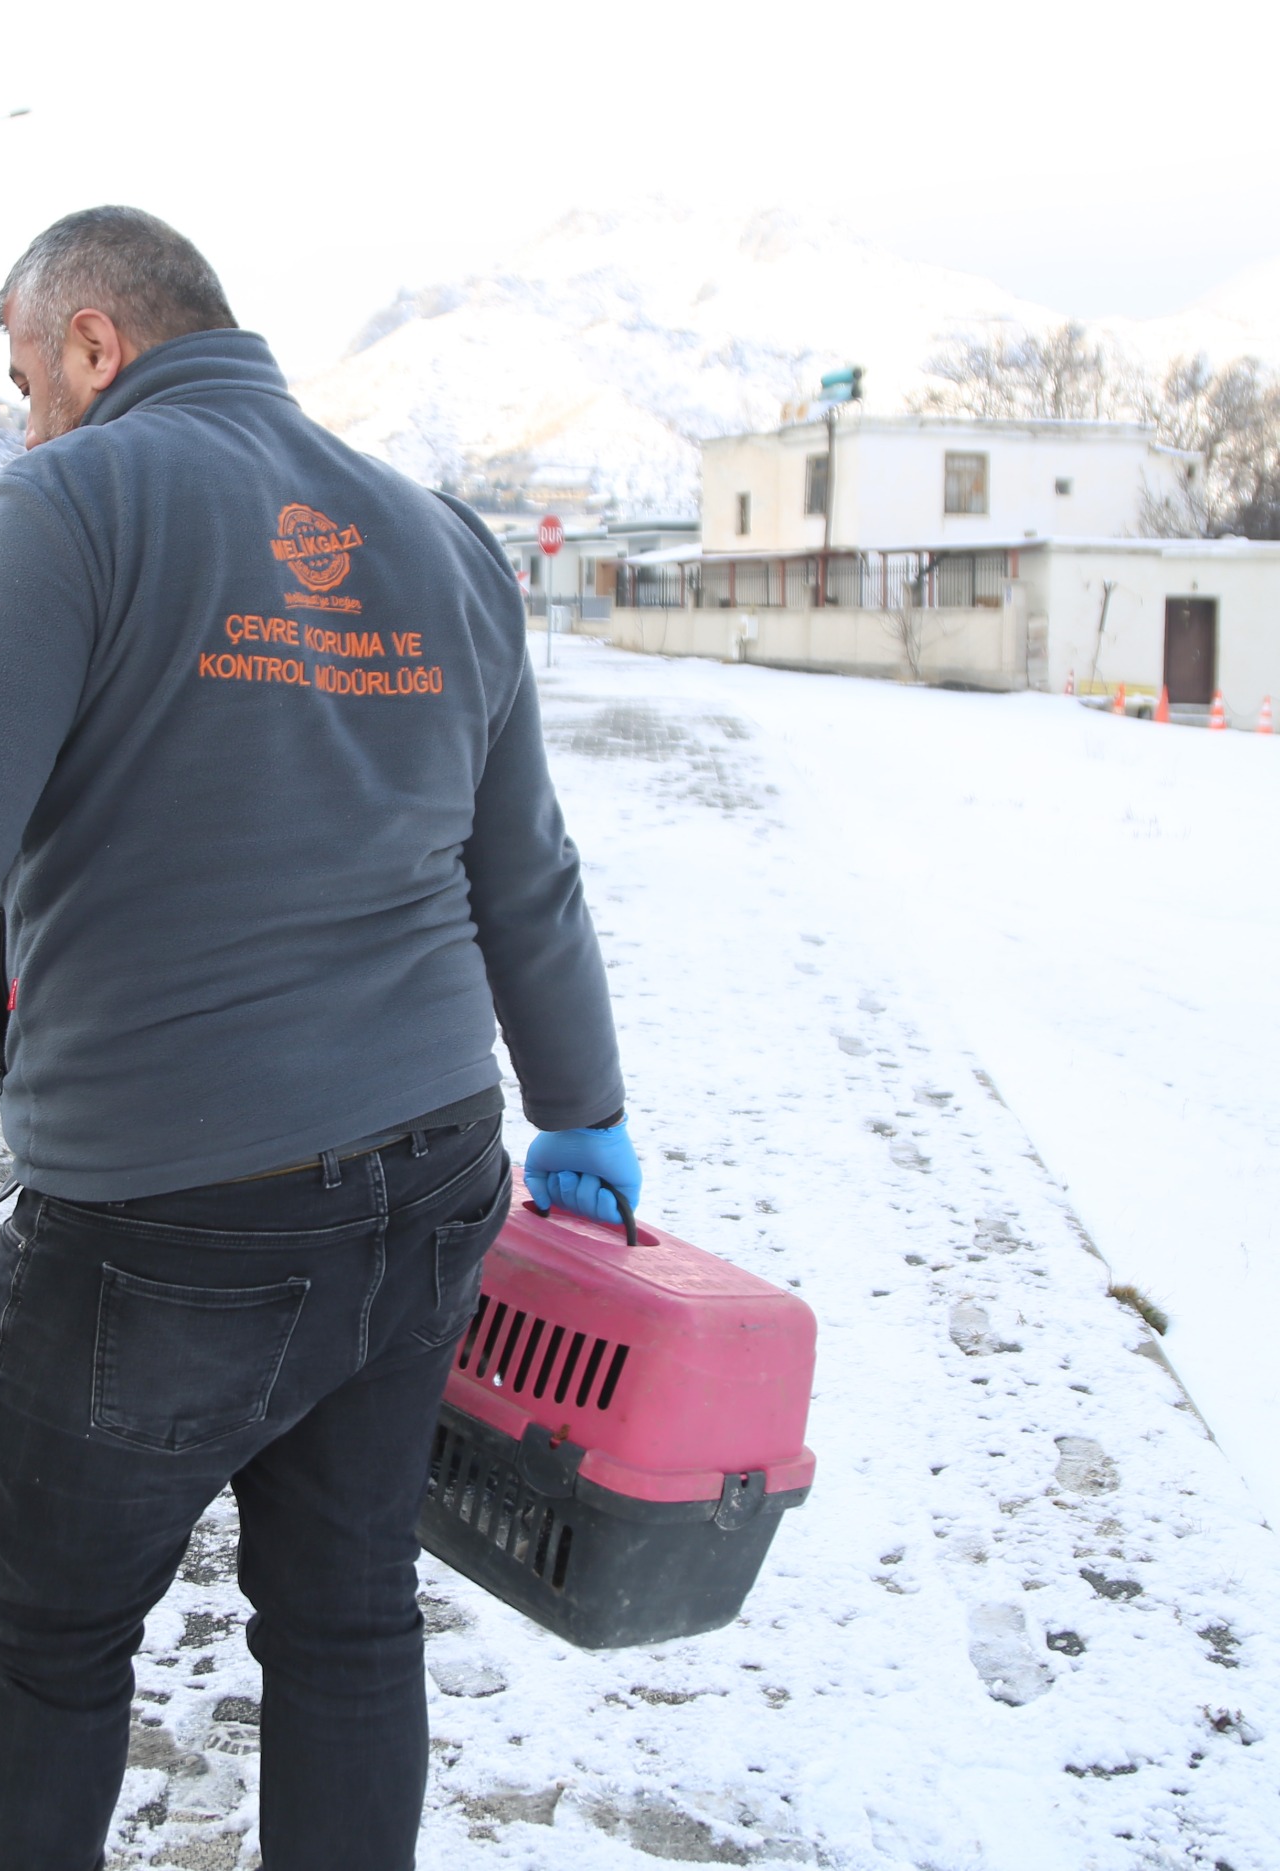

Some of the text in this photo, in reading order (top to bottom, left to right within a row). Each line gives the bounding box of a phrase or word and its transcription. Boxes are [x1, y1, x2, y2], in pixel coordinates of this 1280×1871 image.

[541, 526, 563, 543] DUR
[225, 614, 423, 658] ÇEVRE KORUMA VE
[199, 653, 443, 695] KONTROL MÜDÜRLÜĞÜ
